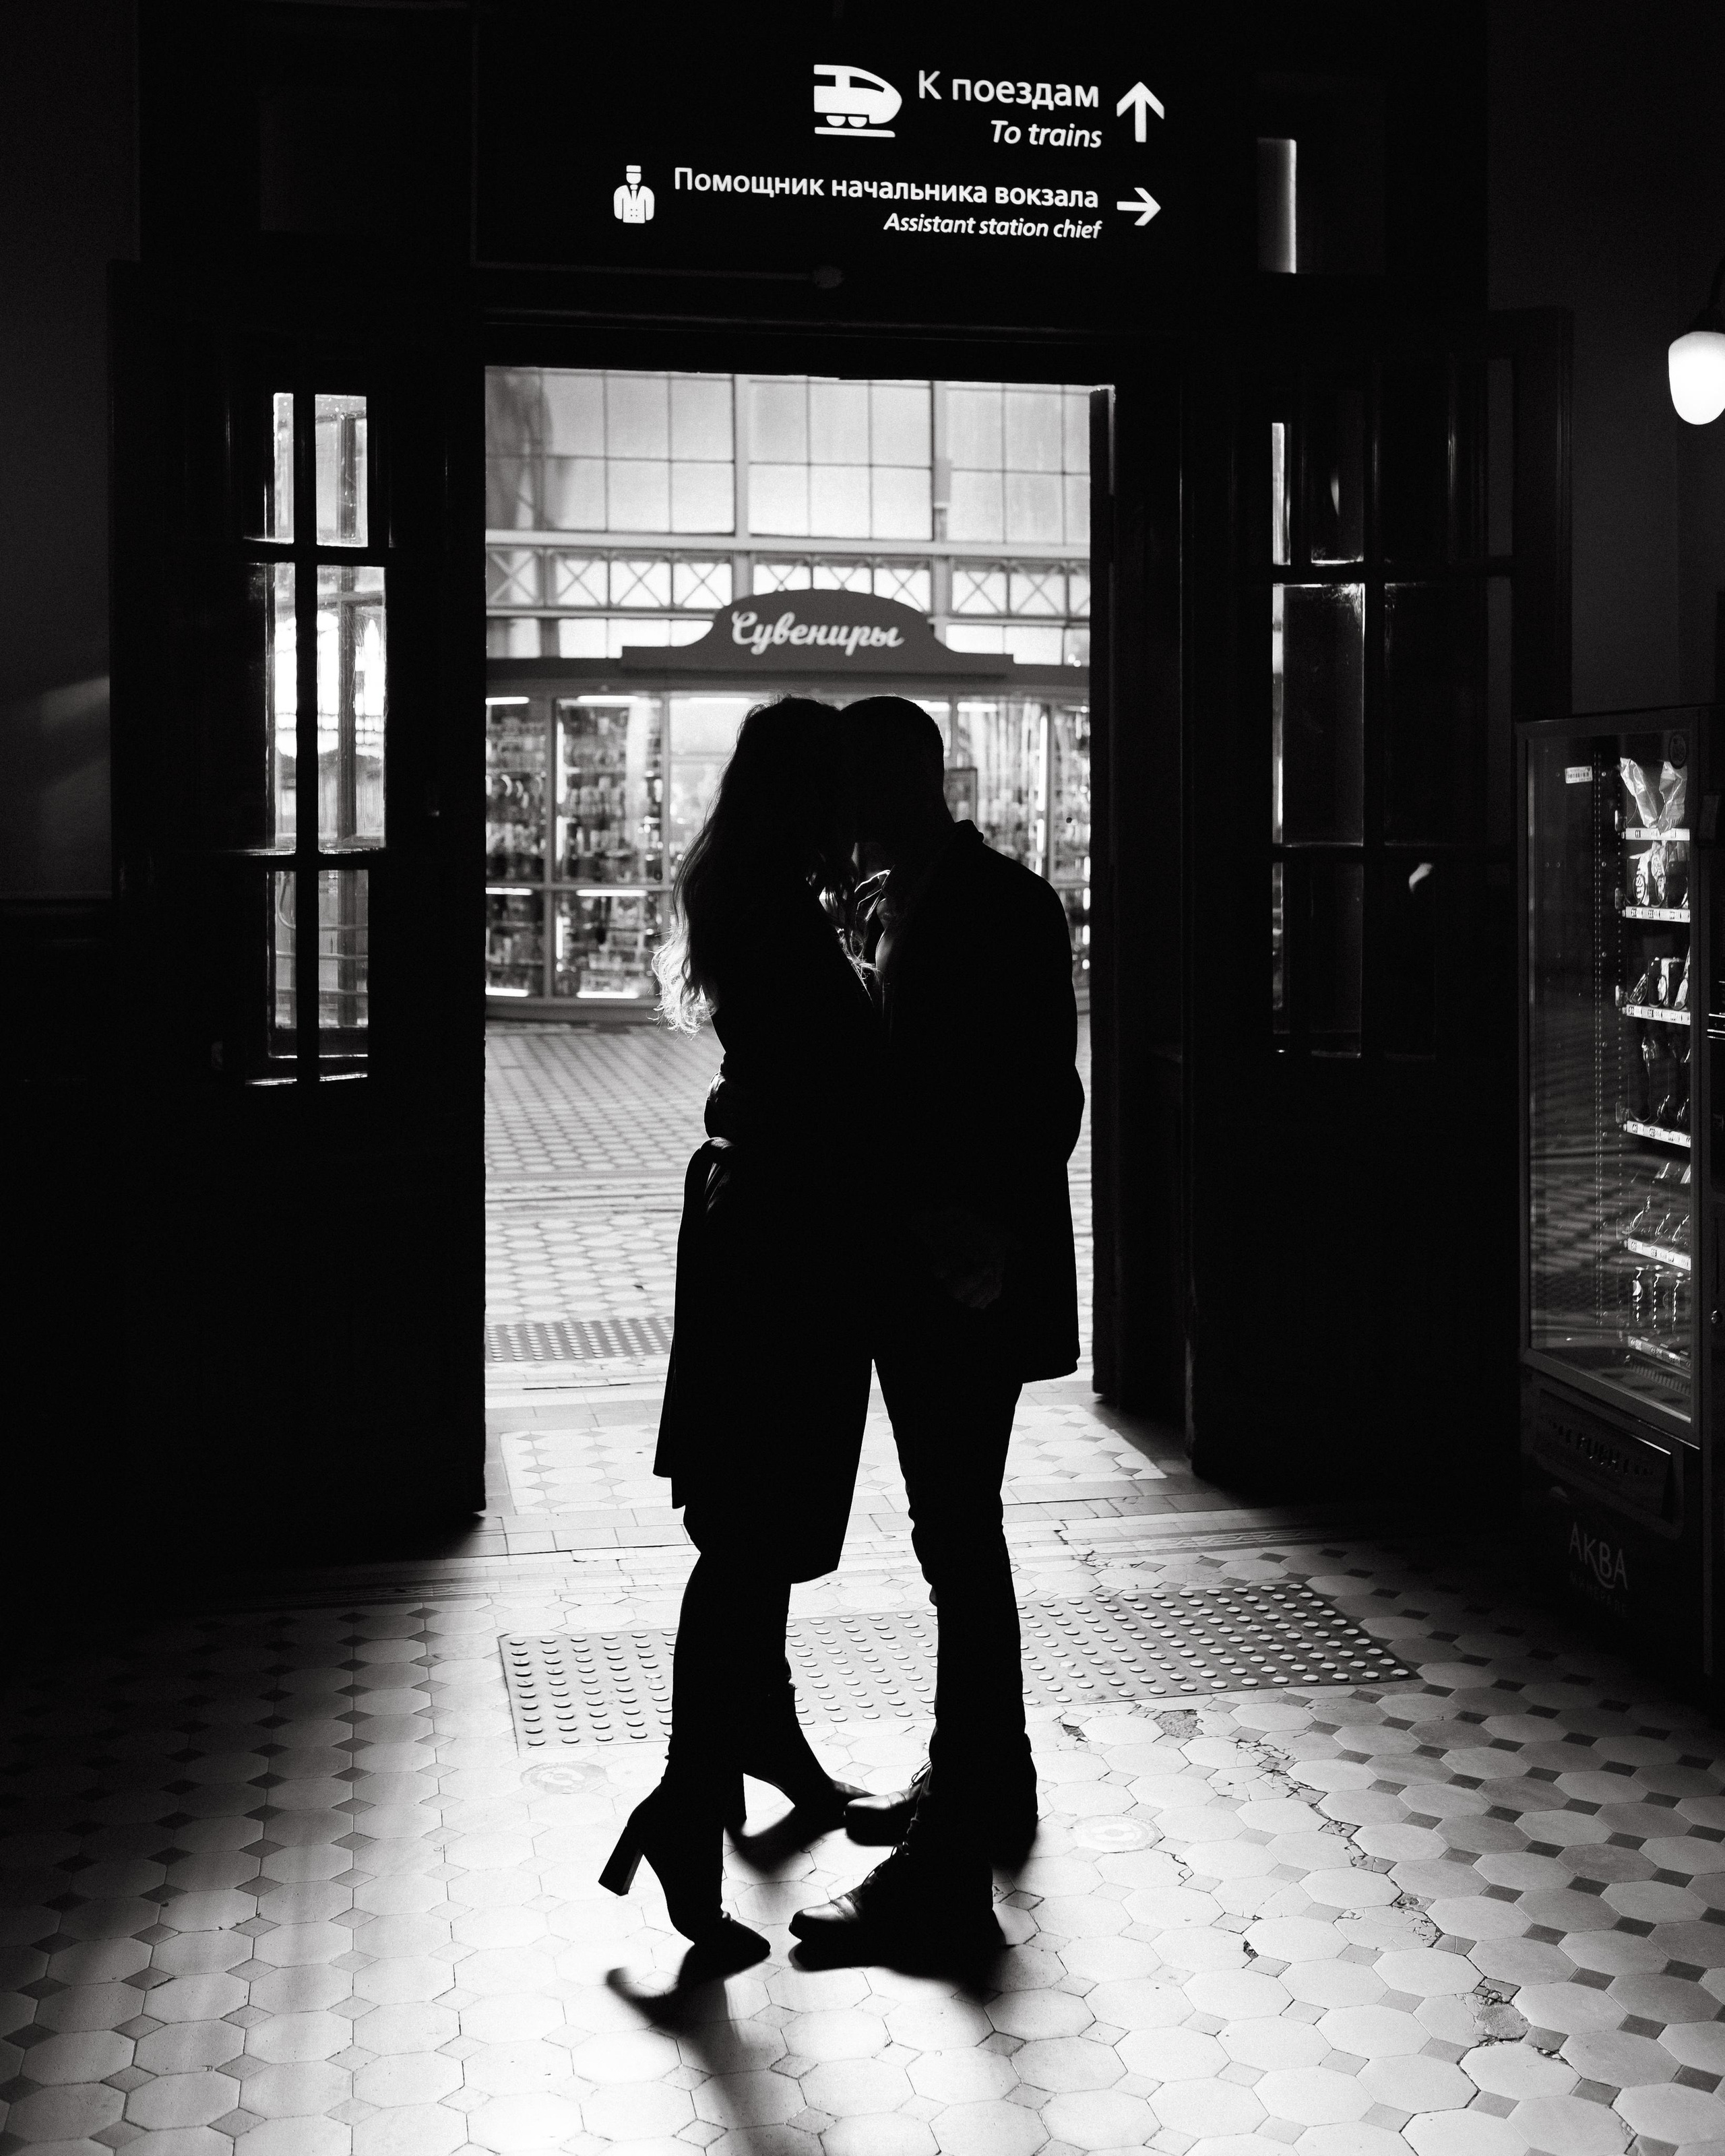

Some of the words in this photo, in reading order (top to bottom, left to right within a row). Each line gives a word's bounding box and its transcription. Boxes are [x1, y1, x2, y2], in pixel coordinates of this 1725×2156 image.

[918, 69, 942, 100] К
[952, 78, 1099, 111] поездам
[991, 119, 1022, 144] To
[1028, 123, 1102, 148] trains
[675, 166, 825, 198] Помощник
[832, 179, 987, 203] начальника
[995, 187, 1098, 208] вокзала
[883, 212, 976, 234] Assistant
[978, 217, 1049, 237] station
[1053, 218, 1103, 239] chief
[731, 611, 904, 656] Сувениры
[1568, 1521, 1629, 1591] АКВА
